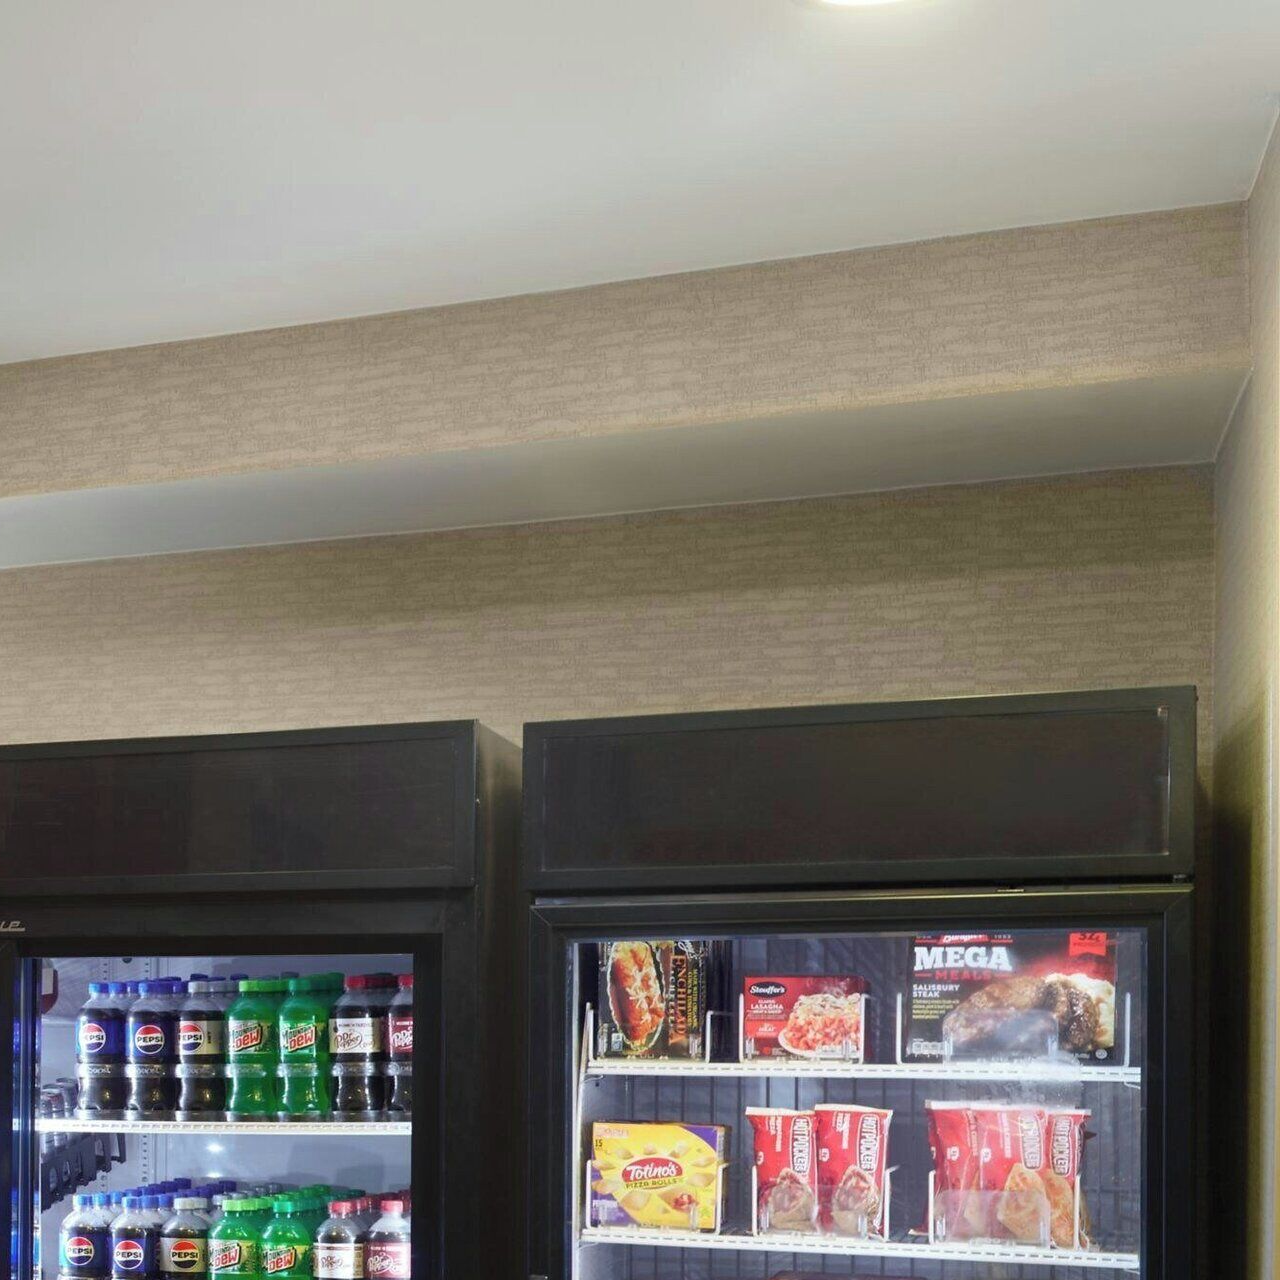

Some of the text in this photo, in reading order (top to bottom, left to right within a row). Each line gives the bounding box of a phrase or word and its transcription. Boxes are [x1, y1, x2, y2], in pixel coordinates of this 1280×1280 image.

[913, 947, 1013, 972] MEGA
[934, 971, 994, 981] MEALS
[749, 983, 786, 996] Stouffer's
[912, 984, 961, 992] SALISBURY
[912, 990, 941, 998] STEAK
[670, 953, 689, 1046] ENCHILADA
[136, 1034, 164, 1044] PEPSI
[234, 1030, 262, 1049] DEW
[288, 1030, 316, 1050] DEW
[594, 1139, 603, 1147] 15
[626, 1162, 677, 1181] Totino's
[626, 1179, 677, 1189] PIZZA ROLLS
[65, 1246, 93, 1256] PEPSI
[114, 1250, 143, 1259] PEPSI
[171, 1250, 199, 1259] PEPSI
[213, 1251, 240, 1268] DEW
[268, 1253, 295, 1270] DEW
